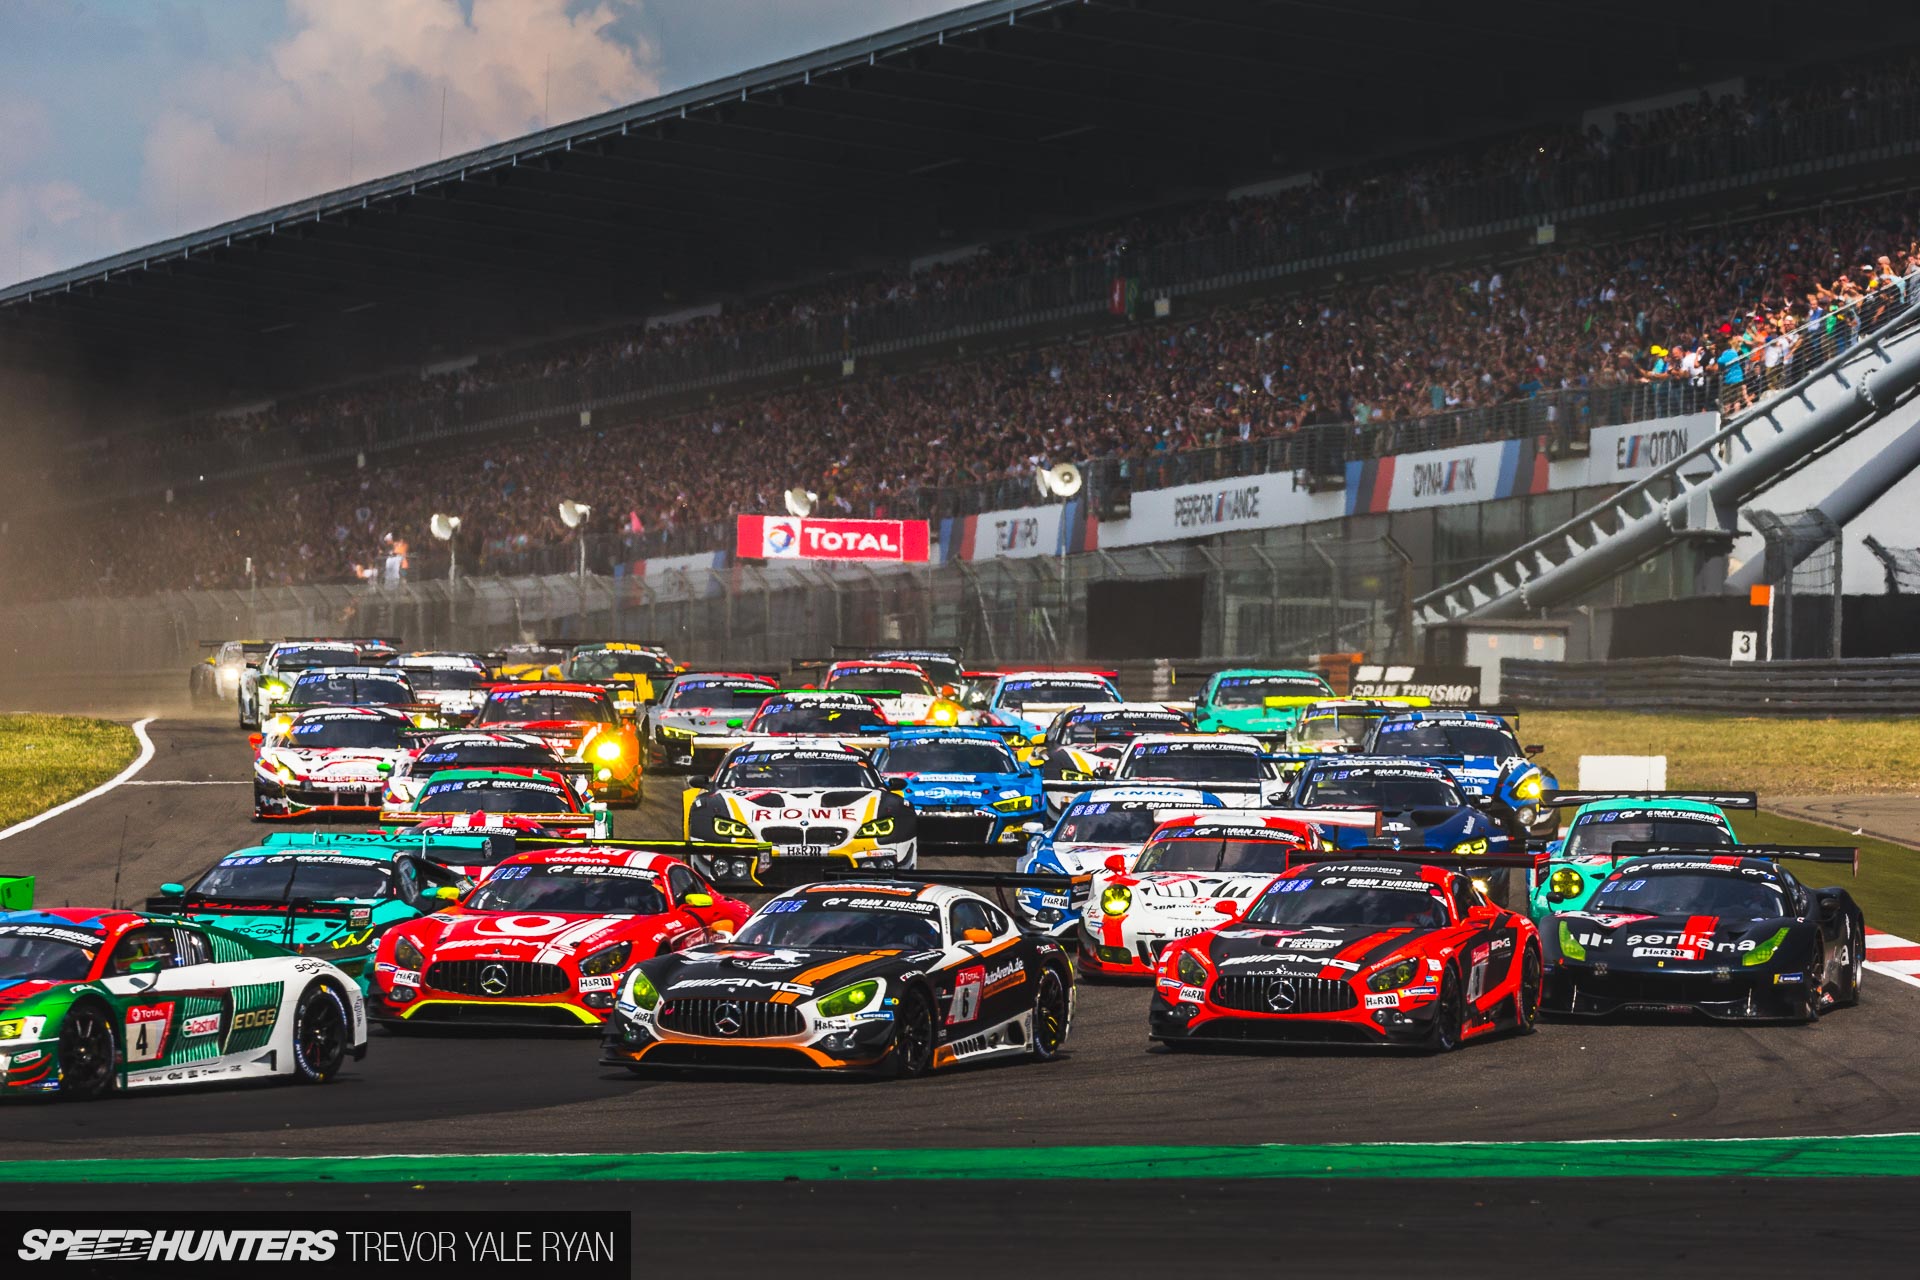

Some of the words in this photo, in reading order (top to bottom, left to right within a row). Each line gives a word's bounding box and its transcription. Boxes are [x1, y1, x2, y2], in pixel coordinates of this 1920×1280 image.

[804, 527, 898, 551] TOTAL
[1739, 634, 1751, 654] 3
[1352, 684, 1399, 697] GRAN
[794, 752, 820, 760] GRAN
[821, 752, 861, 762] TURISMO
[1403, 769, 1443, 779] TURISMO
[492, 780, 519, 788] GRAN
[520, 781, 560, 794] TURISMO
[754, 808, 857, 822] ROWE
[1646, 810, 1675, 818] GRAN
[1677, 811, 1721, 823] TURISMO
[443, 826, 476, 835] GRAN
[478, 825, 518, 836] TURISMO
[787, 846, 808, 857] H&R
[544, 856, 610, 864] vodafone
[1652, 861, 1684, 870] GRAN
[1685, 862, 1736, 871] TURISMO
[573, 865, 606, 874] GRAN
[607, 867, 659, 879] TURISMO
[1348, 878, 1380, 887] GRAN
[1381, 879, 1433, 890] TURISMO
[849, 898, 883, 907] GRAN
[884, 900, 935, 912] TURISMO
[1043, 896, 1060, 905] H&R
[17, 926, 53, 934] GRAN
[49, 928, 102, 944] TURISMO
[1174, 927, 1199, 937] H&R
[490, 938, 577, 956] AMG
[1264, 954, 1361, 972] AMG
[396, 971, 413, 982] H&R
[964, 972, 980, 981] TOTAL
[1283, 970, 1318, 978] FALCON
[580, 978, 600, 988] H&R
[711, 978, 815, 997] AMG
[1181, 988, 1198, 998] H&R
[962, 987, 970, 1018] 6
[1366, 995, 1385, 1006] H&R
[140, 1008, 164, 1018] TOTAL
[191, 1016, 219, 1033] Castrol
[234, 1008, 276, 1031] EDGE
[814, 1020, 835, 1031] H&R
[136, 1023, 148, 1056] 4
